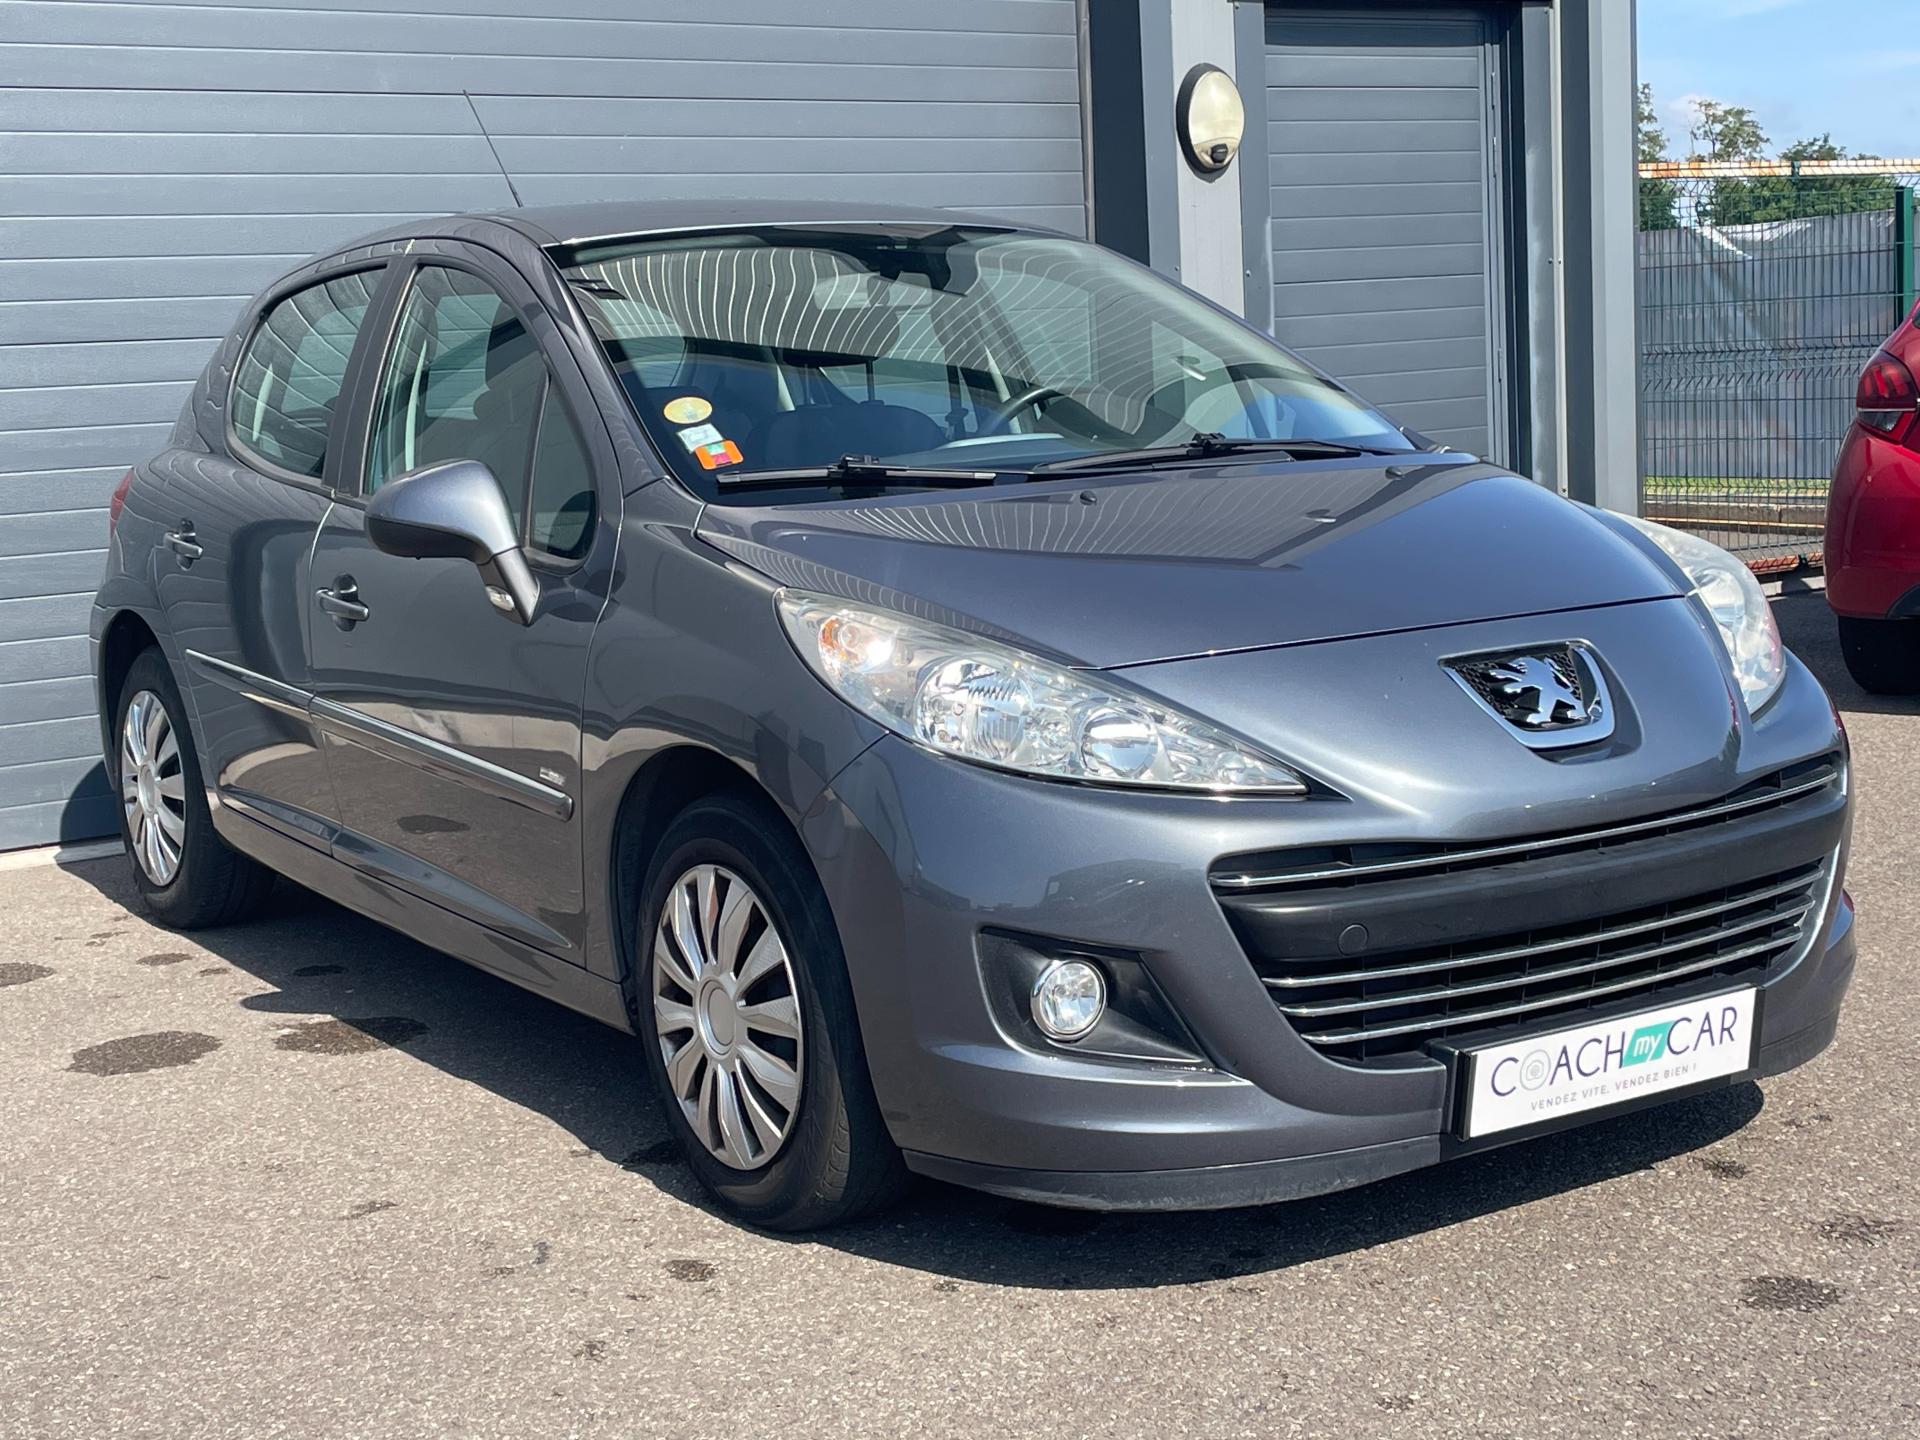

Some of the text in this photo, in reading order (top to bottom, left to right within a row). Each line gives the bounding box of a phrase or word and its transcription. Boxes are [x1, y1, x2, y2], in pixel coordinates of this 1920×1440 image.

[1633, 1033, 1662, 1062] my
[1667, 1006, 1738, 1055] CAR
[1531, 1092, 1577, 1111] VENDEZ
[1615, 1072, 1659, 1091] VENDEZ
